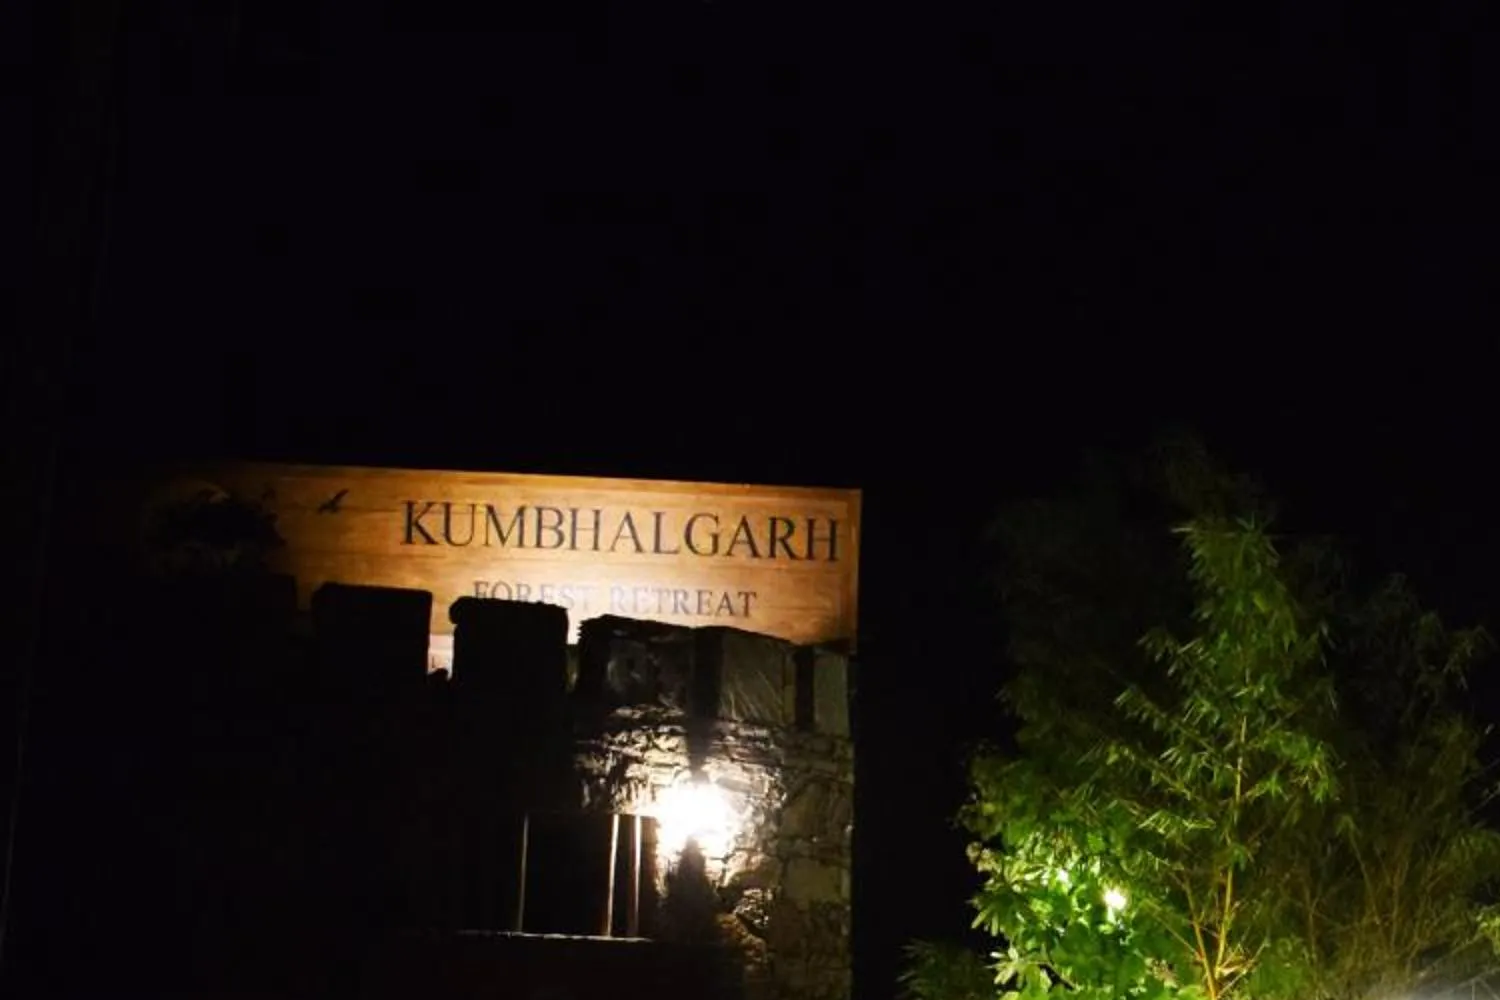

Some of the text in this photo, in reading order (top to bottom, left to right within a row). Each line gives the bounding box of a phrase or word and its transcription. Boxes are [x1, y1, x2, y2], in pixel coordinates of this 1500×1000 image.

[402, 500, 839, 562] KUMBHALGARH
[473, 580, 757, 618] FOREST RETREAT
